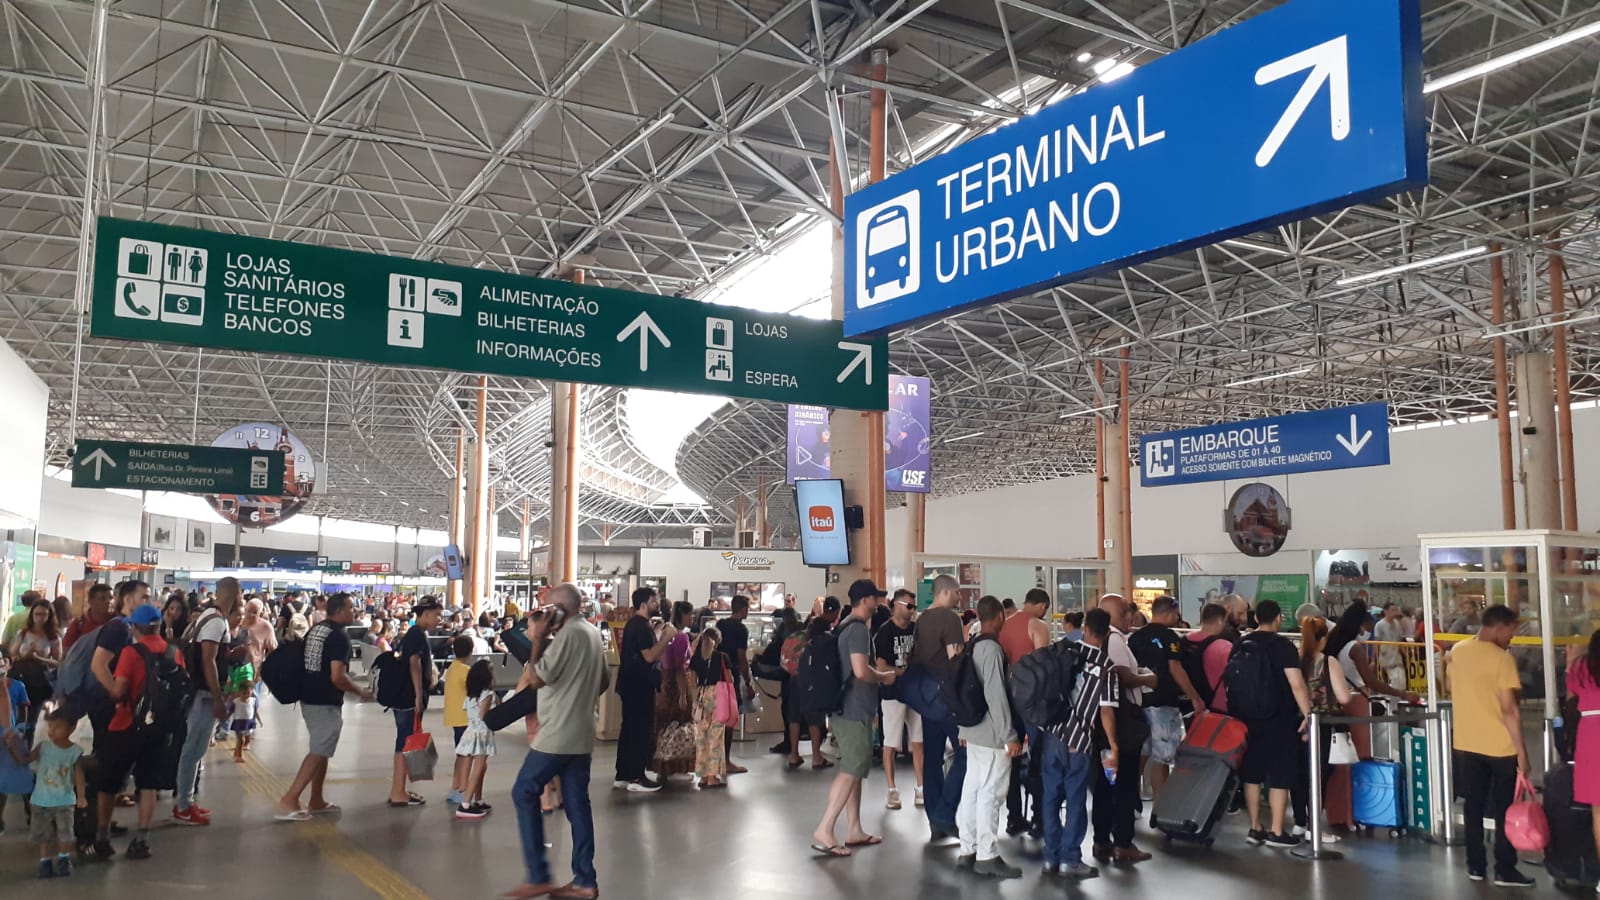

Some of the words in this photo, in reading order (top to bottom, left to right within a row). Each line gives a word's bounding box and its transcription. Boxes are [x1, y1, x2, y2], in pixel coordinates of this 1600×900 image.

[936, 95, 1166, 220] TERMINAL
[935, 182, 1121, 283] URBANO
[226, 252, 291, 274] LOJAS
[224, 271, 345, 299] SANITÁRIOS
[224, 292, 345, 320] TELEFONES
[479, 285, 599, 316] ALIMENTAÇÃO
[224, 313, 312, 336] BANCOS
[477, 311, 585, 338] BILHETERIAS
[745, 321, 788, 339] LOJAS
[476, 339, 601, 367] INFORMAÇÕES
[745, 370, 799, 389] ESPERA
[254, 428, 270, 439] 12
[1180, 425, 1279, 454] EMBARQUE
[128, 448, 190, 460] BILHETERIAS
[1180, 450, 1237, 465] PLATAFORMAS
[1238, 449, 1249, 458] DE
[1251, 448, 1261, 457] 01
[1271, 445, 1280, 453] 40
[1181, 463, 1208, 475] ACESSO
[1208, 460, 1240, 473] SOMENTE
[1241, 458, 1258, 469] COM
[1258, 454, 1287, 467] BILHETE
[1287, 450, 1332, 464] MAGNÉTICO
[126, 475, 215, 487] ESTACIONAMENTO
[299, 472, 309, 482] 3
[902, 469, 926, 485] USF
[250, 511, 260, 522] 6
[811, 516, 833, 527] itaú
[1414, 741, 1425, 829] ENTRADA
